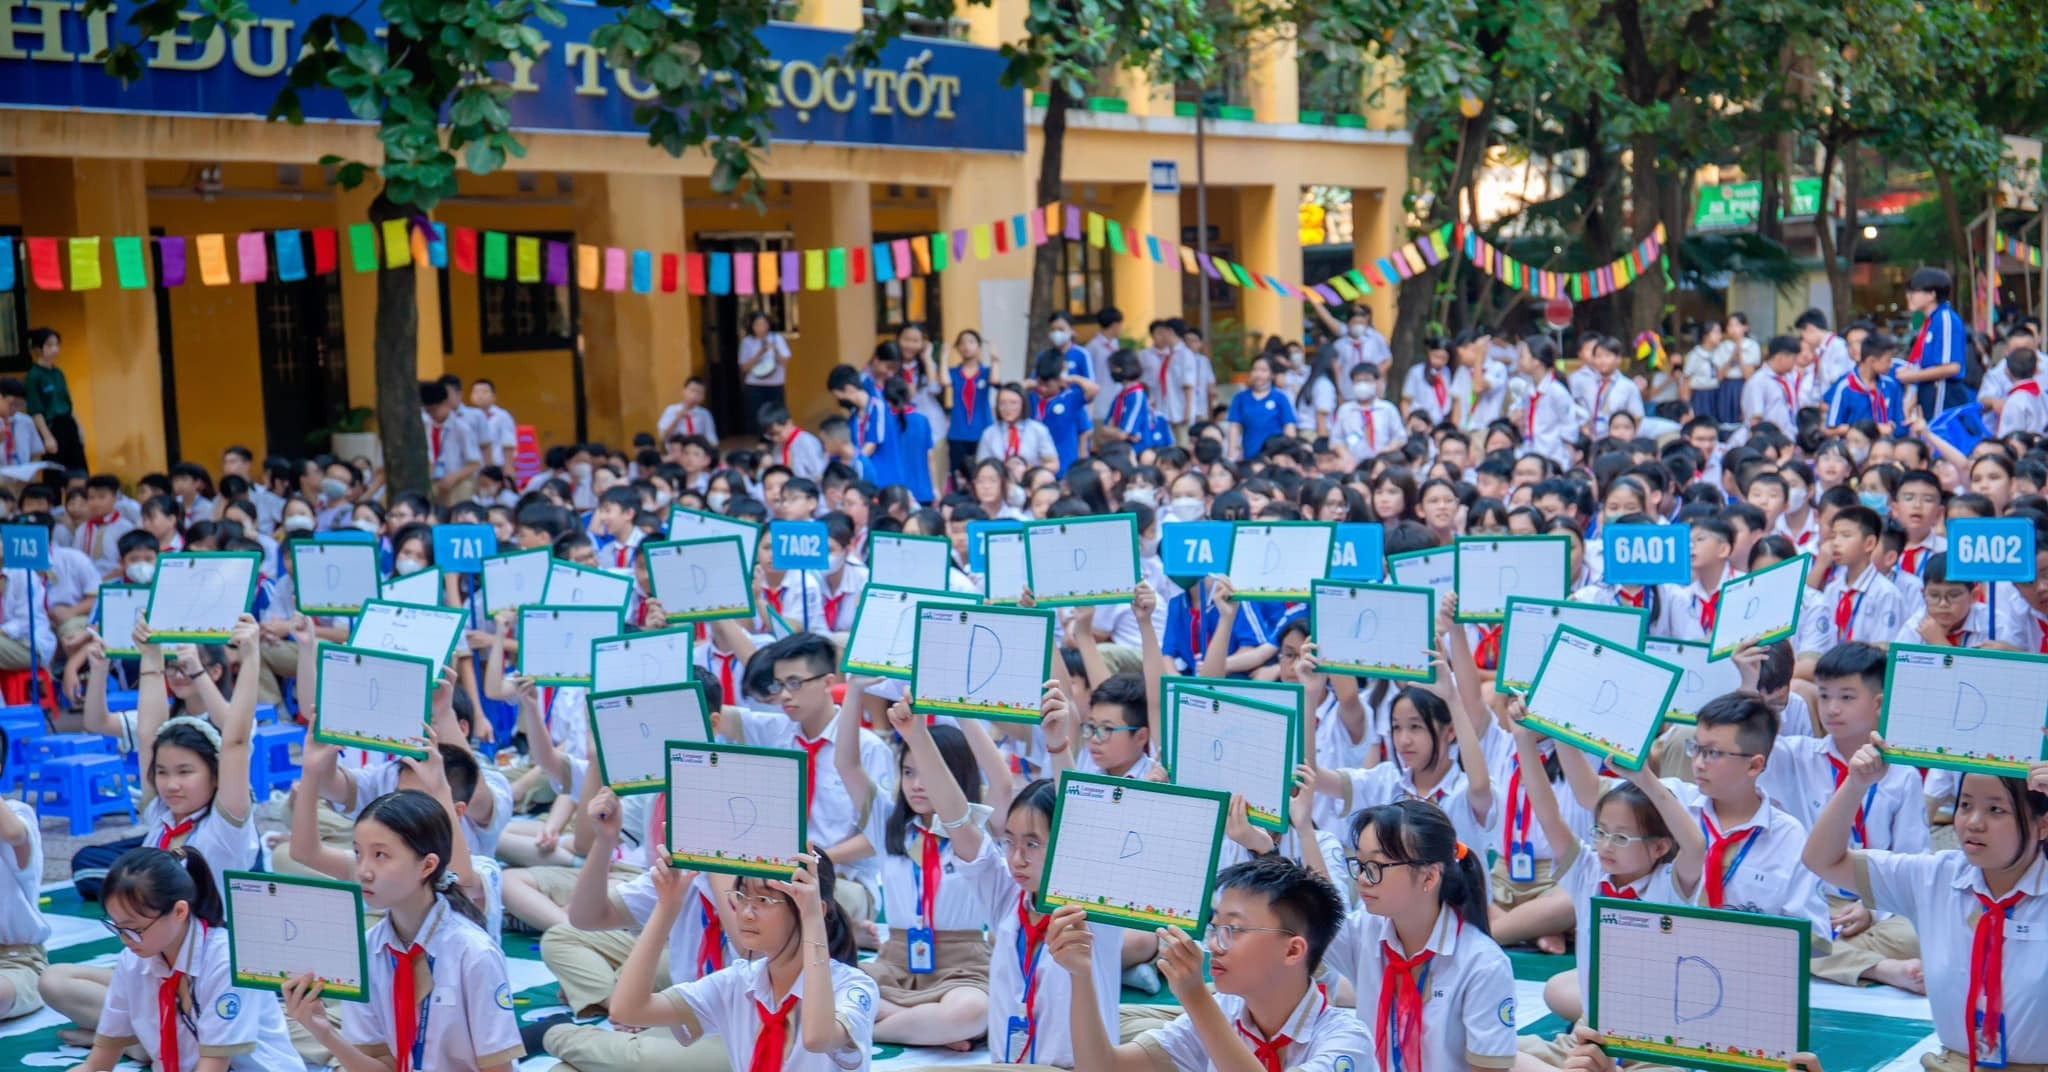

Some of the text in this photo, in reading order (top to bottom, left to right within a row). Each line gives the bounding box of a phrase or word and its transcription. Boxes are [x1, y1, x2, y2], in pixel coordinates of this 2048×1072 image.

[146, 10, 342, 79] ĐU
[863, 49, 960, 119] TỐT
[12, 536, 38, 558] 7A3
[450, 537, 484, 560] 7A1
[778, 534, 822, 558] 7A02
[1073, 547, 1087, 572] D
[1183, 538, 1214, 565] 7A
[1614, 536, 1676, 565] 6A01
[1957, 534, 2023, 565] 6A02
[327, 563, 342, 593] D
[691, 564, 707, 595] D
[966, 623, 1003, 695] D
[1952, 680, 1988, 732] D
[1213, 738, 1224, 761] D
[727, 795, 758, 841] D
[1119, 830, 1144, 859] D
[284, 918, 297, 942] D
[1673, 954, 1724, 1025] D
